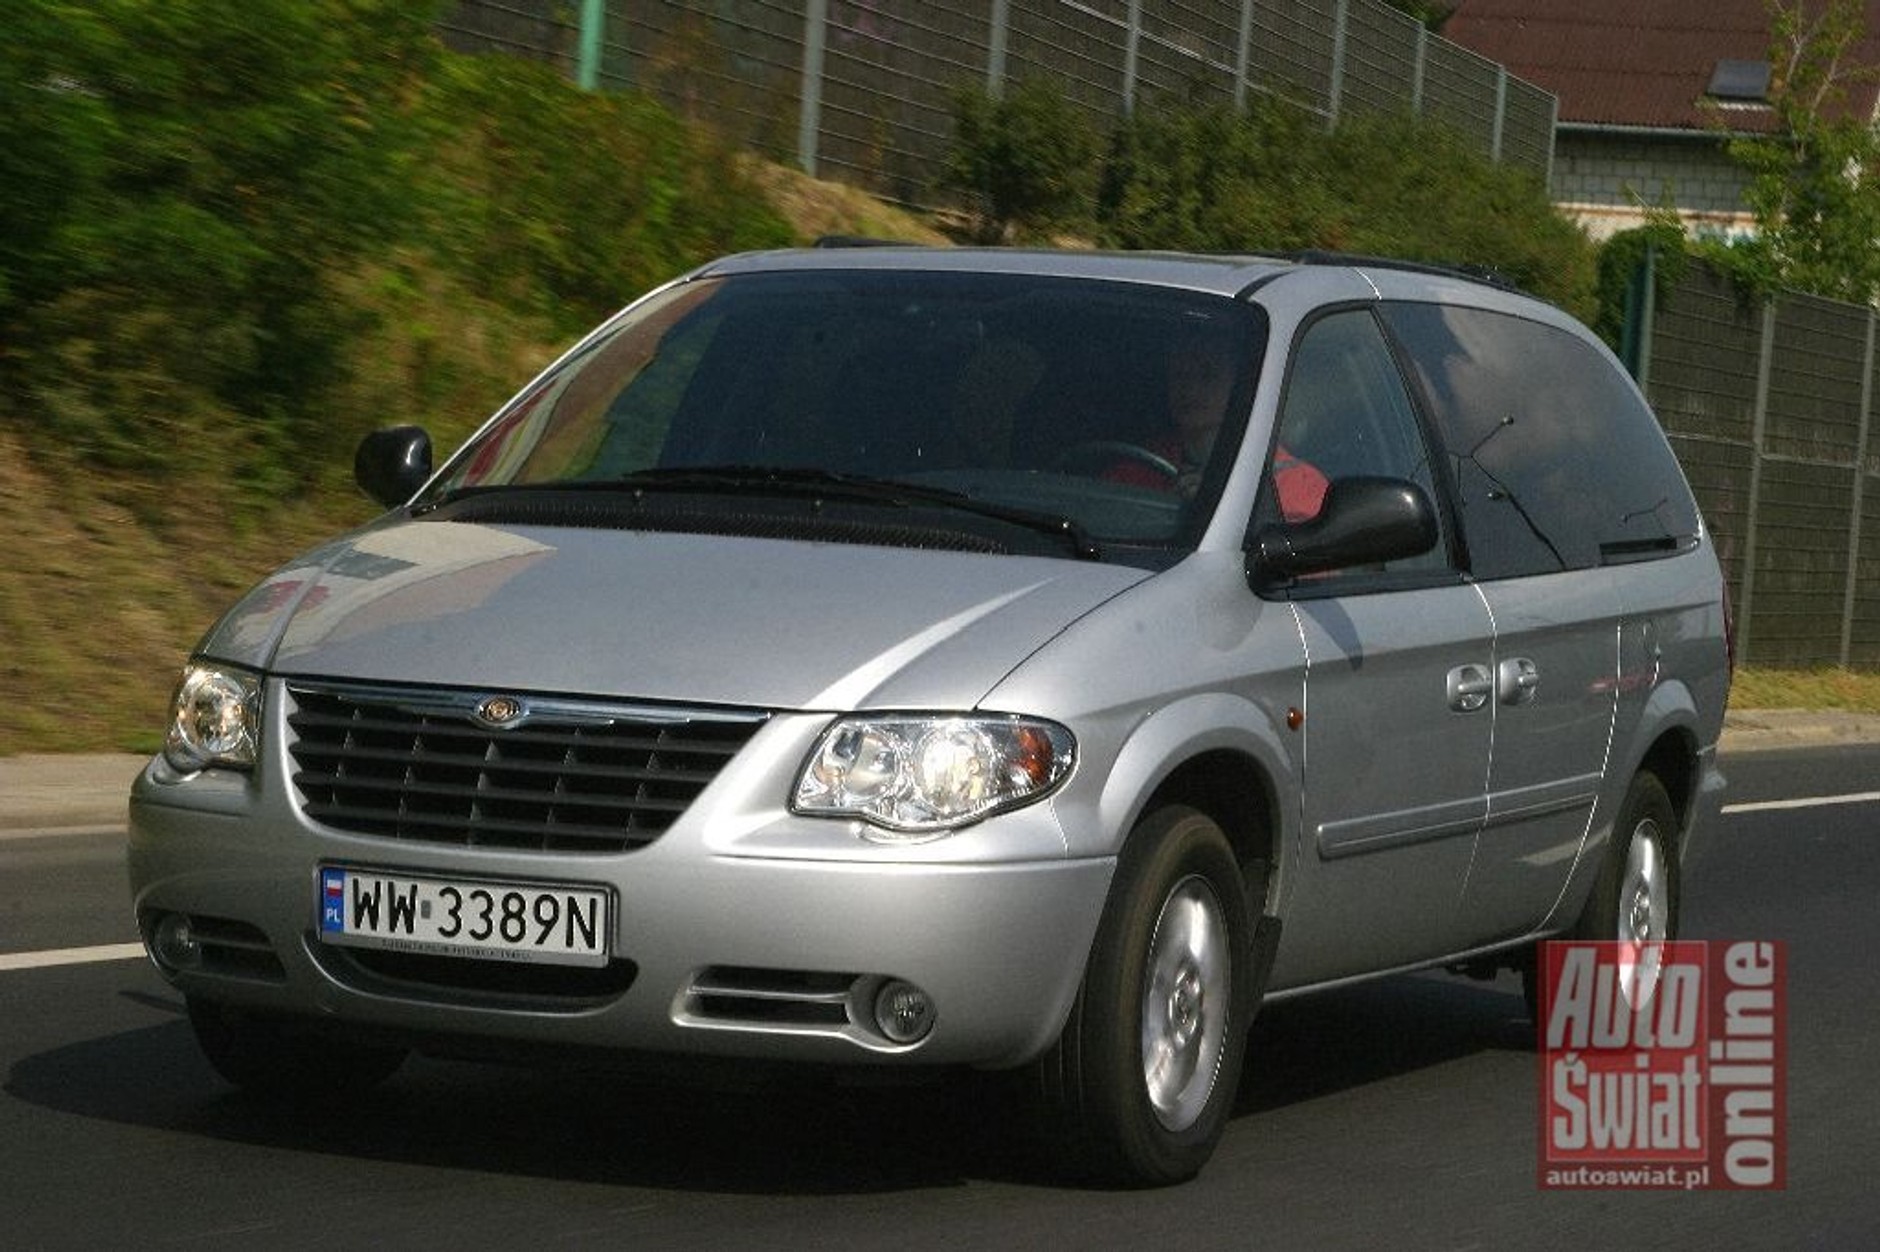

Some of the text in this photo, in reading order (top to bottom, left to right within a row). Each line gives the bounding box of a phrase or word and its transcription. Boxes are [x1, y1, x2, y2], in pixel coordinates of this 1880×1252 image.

[326, 908, 341, 923] PL
[352, 878, 418, 934] WW
[437, 886, 597, 949] 3389N
